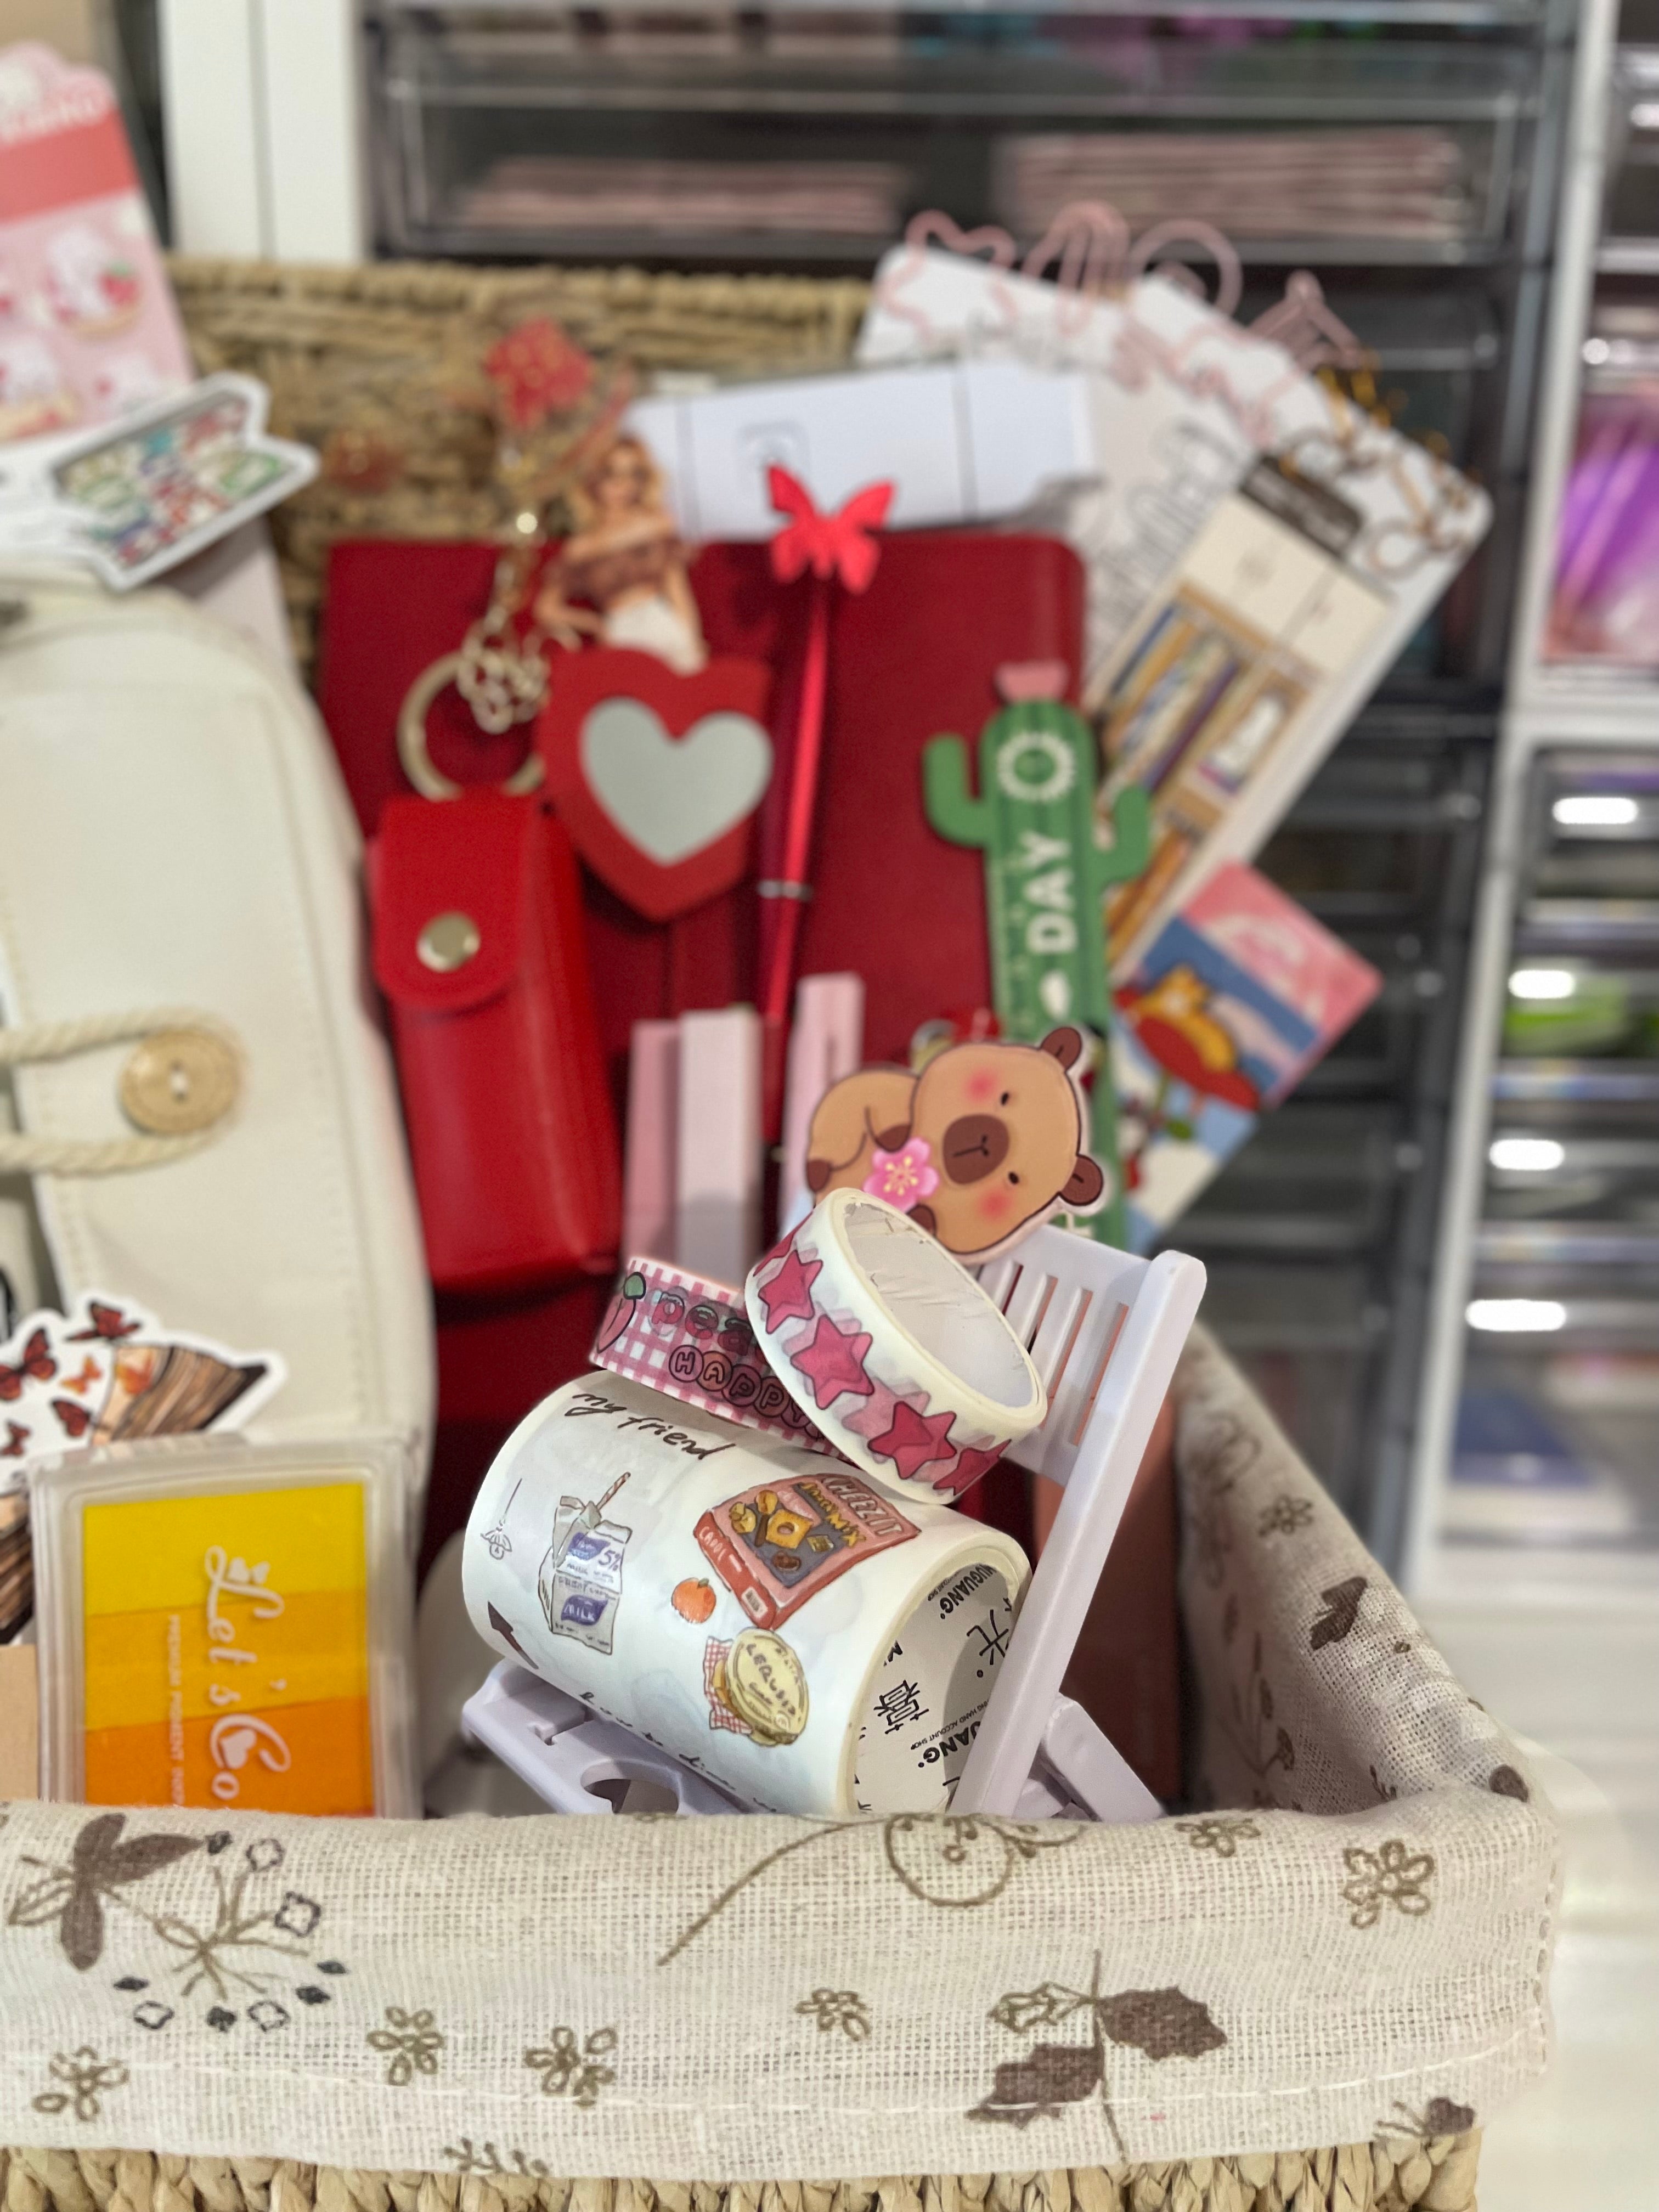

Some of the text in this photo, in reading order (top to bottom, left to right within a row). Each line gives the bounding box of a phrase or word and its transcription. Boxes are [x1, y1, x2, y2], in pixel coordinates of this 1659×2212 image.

[1020, 828, 1077, 955] DAY
[565, 1393, 736, 1460] my friend
[873, 1679, 929, 1734] 暮
[929, 1719, 958, 1742] ACCOUNT
